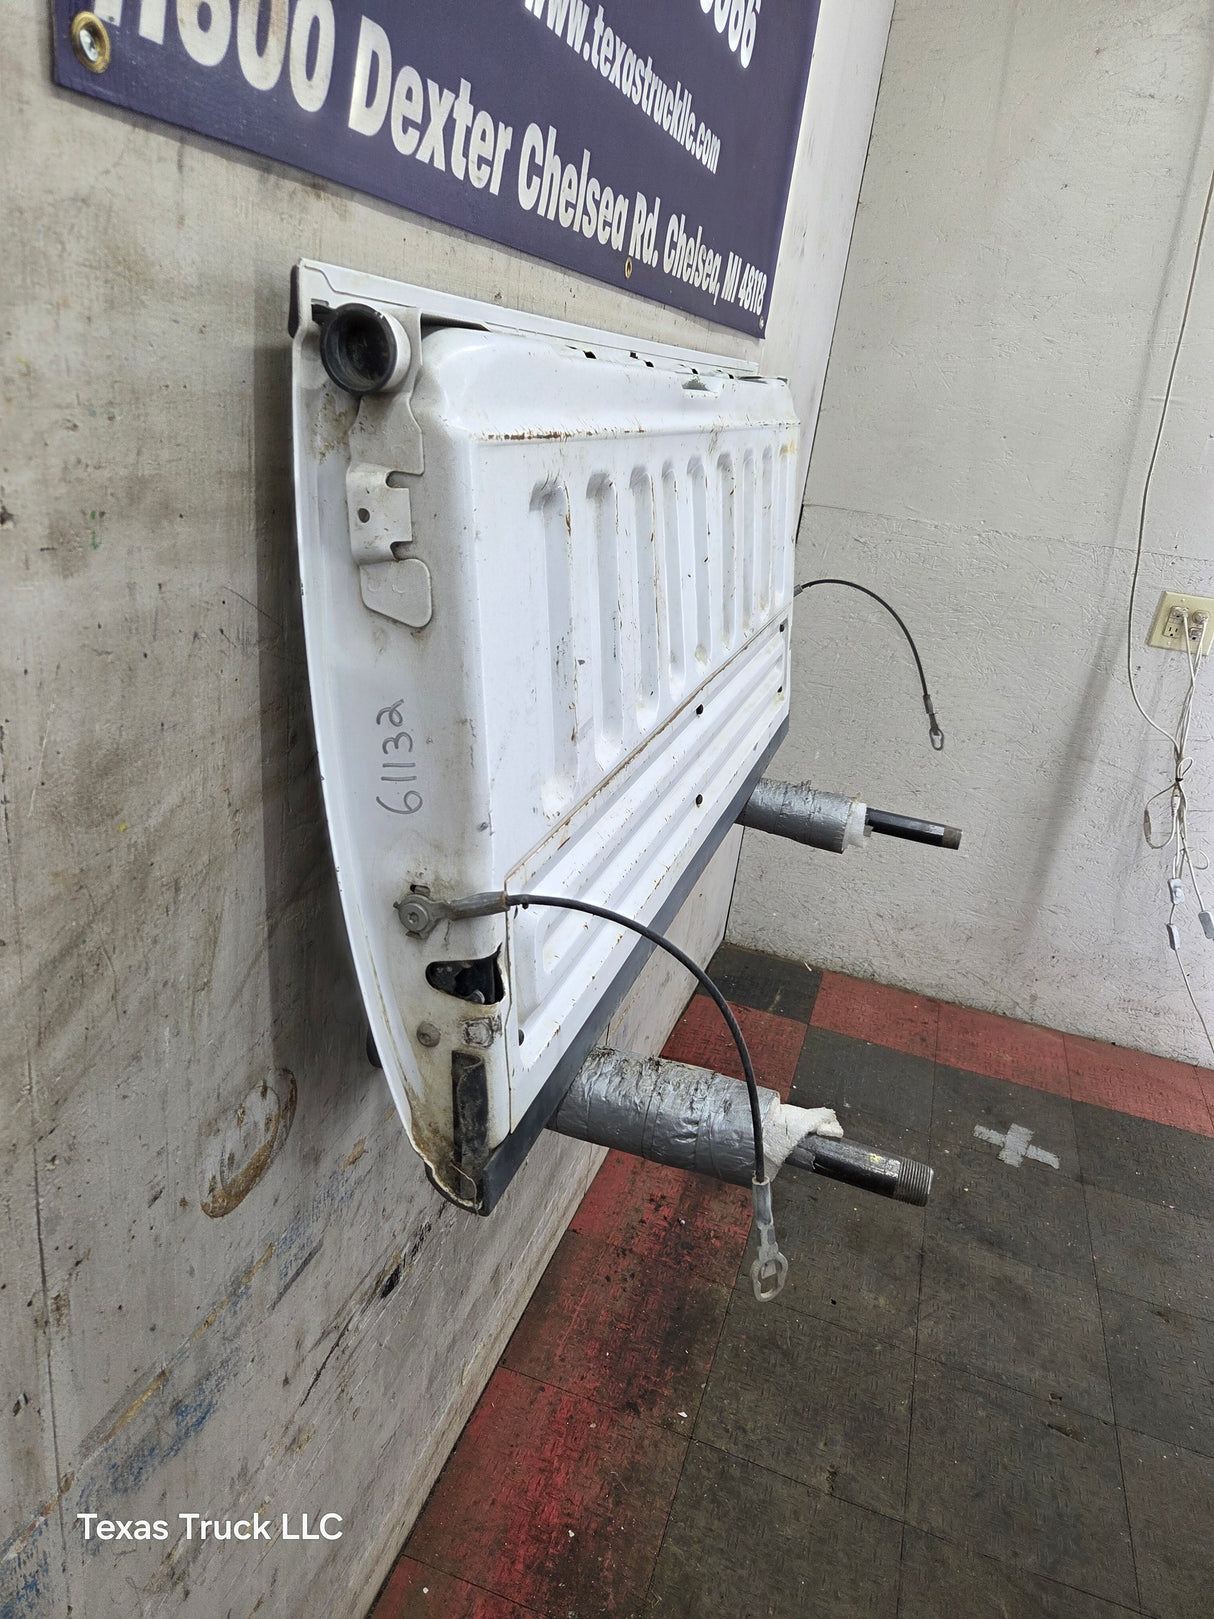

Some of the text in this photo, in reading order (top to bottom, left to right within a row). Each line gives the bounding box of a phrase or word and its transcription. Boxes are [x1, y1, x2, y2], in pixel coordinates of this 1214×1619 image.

[348, 15, 513, 196] Dexter
[518, 123, 629, 252] Chelsea
[628, 191, 661, 268] Rd.
[663, 213, 722, 306] Chelsea,
[720, 251, 743, 304] MI
[737, 262, 768, 316] 48118
[376, 698, 424, 815] 61132
